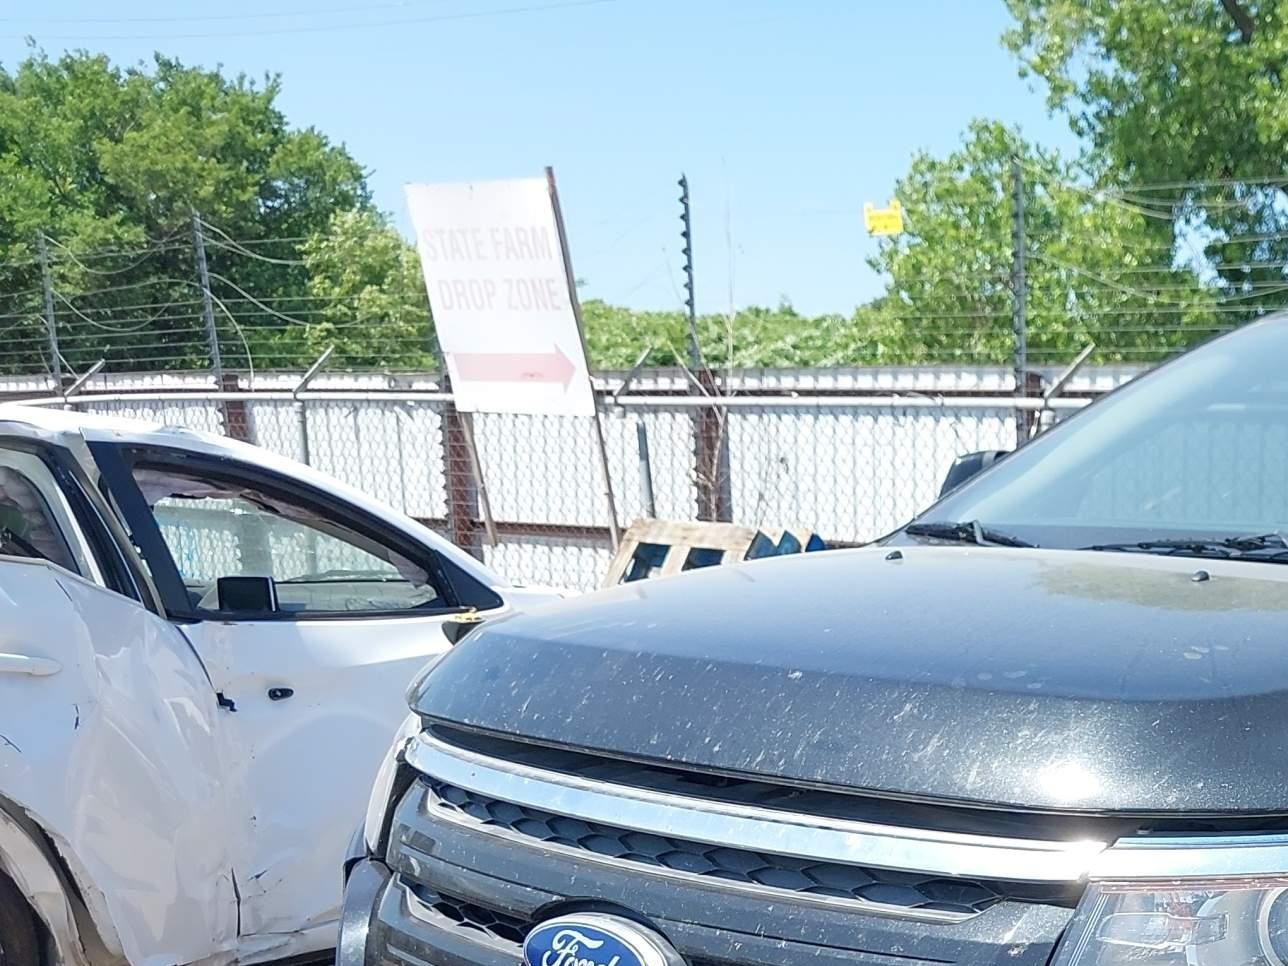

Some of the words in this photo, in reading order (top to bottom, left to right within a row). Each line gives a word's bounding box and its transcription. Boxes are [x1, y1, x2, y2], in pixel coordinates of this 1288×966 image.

[423, 228, 488, 261] STATE
[491, 227, 552, 260] FARM
[438, 279, 496, 310] DROP
[505, 279, 561, 310] ZONE
